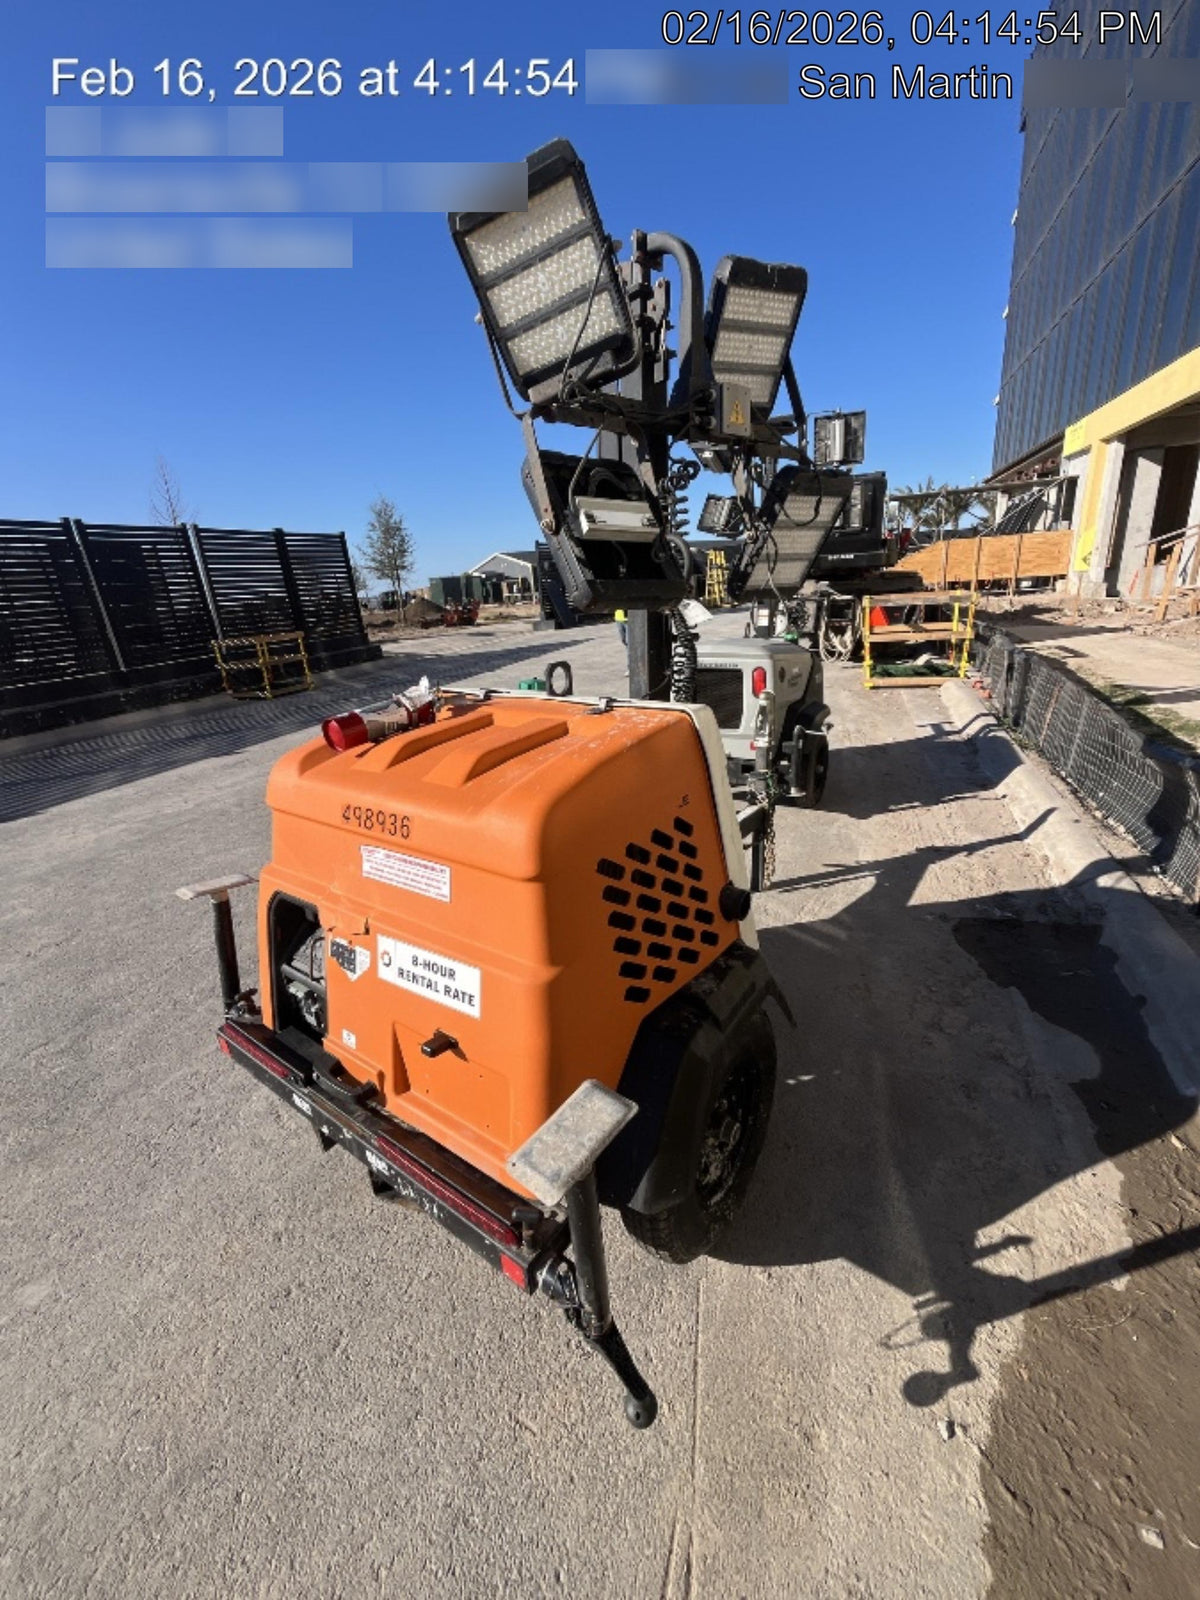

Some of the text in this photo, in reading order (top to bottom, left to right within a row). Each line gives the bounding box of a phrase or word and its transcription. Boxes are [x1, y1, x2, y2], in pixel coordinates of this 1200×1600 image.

[342, 803, 410, 840] 498936
[411, 954, 456, 981] 8-HOUR
[397, 967, 476, 1007] RENTAL RATE
